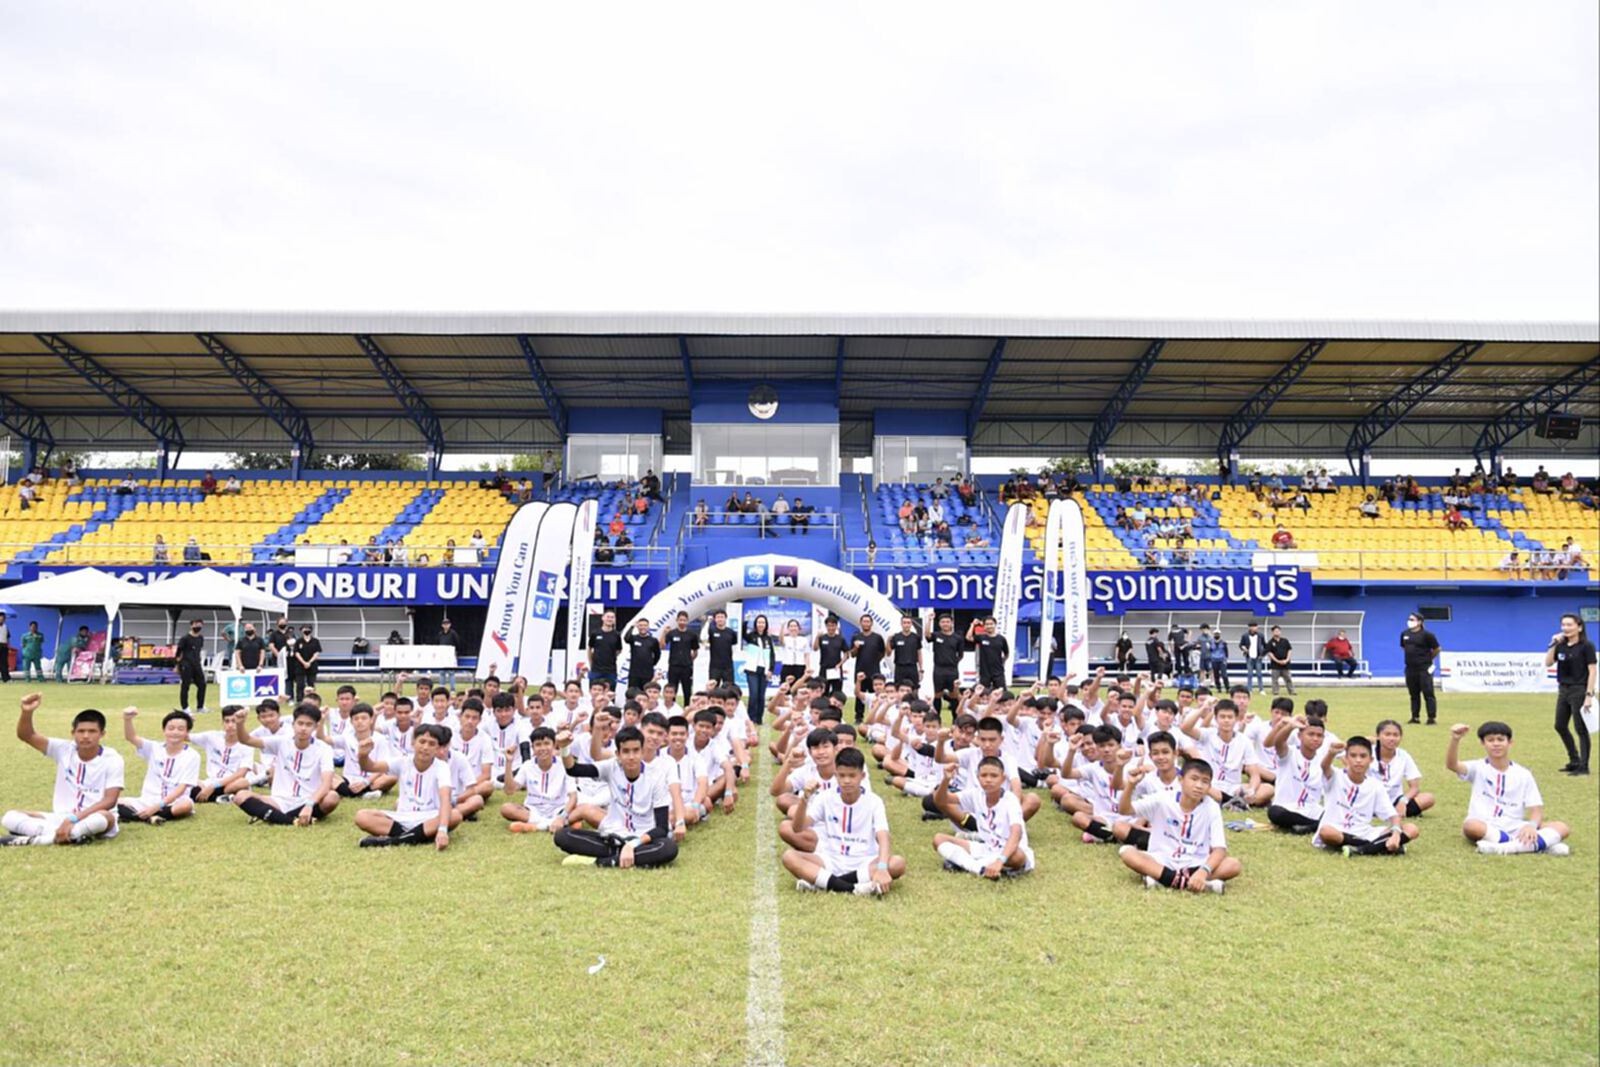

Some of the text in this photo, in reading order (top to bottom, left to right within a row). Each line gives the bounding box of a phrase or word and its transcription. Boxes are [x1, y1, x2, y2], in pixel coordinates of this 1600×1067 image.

[497, 542, 528, 641] Know You Can
[678, 590, 704, 606] You
[707, 579, 733, 592] Can
[811, 577, 891, 632] Football Youth
